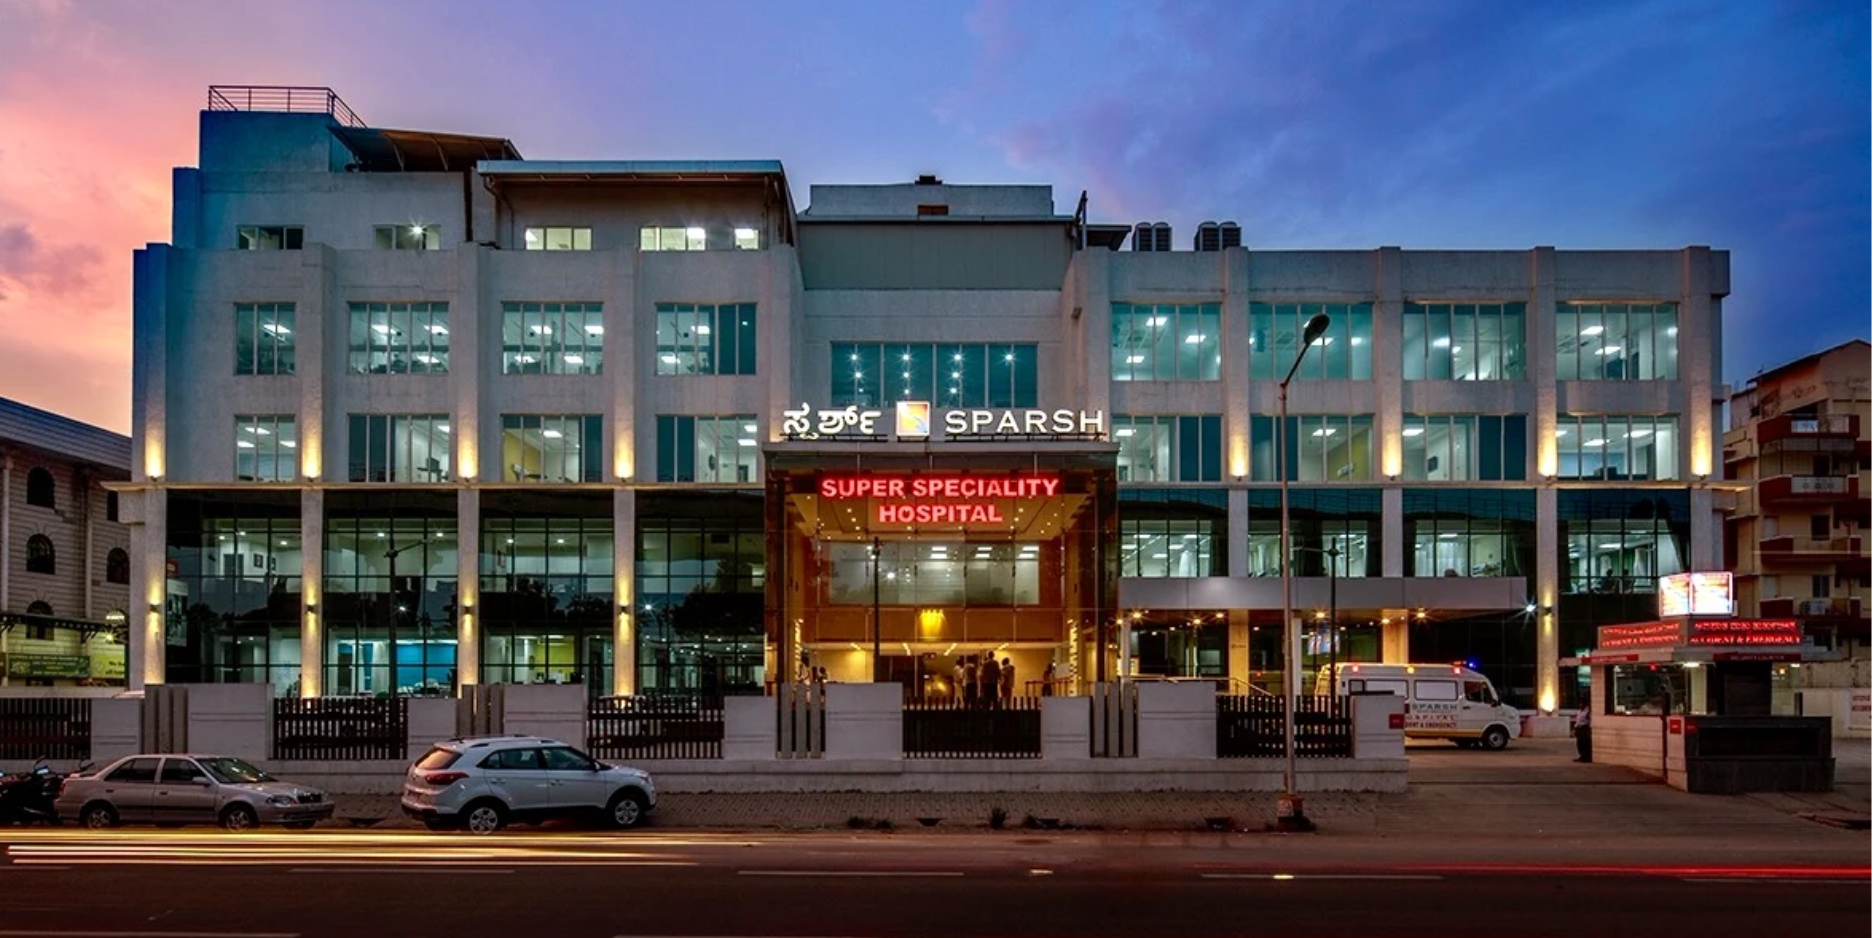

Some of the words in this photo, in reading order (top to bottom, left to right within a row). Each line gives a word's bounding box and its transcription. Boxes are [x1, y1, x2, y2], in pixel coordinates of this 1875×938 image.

[945, 409, 1103, 434] SPARSH
[821, 479, 905, 497] SUPER
[912, 479, 1059, 497] SPECIALITY
[878, 504, 1003, 523] HOSPITAL
